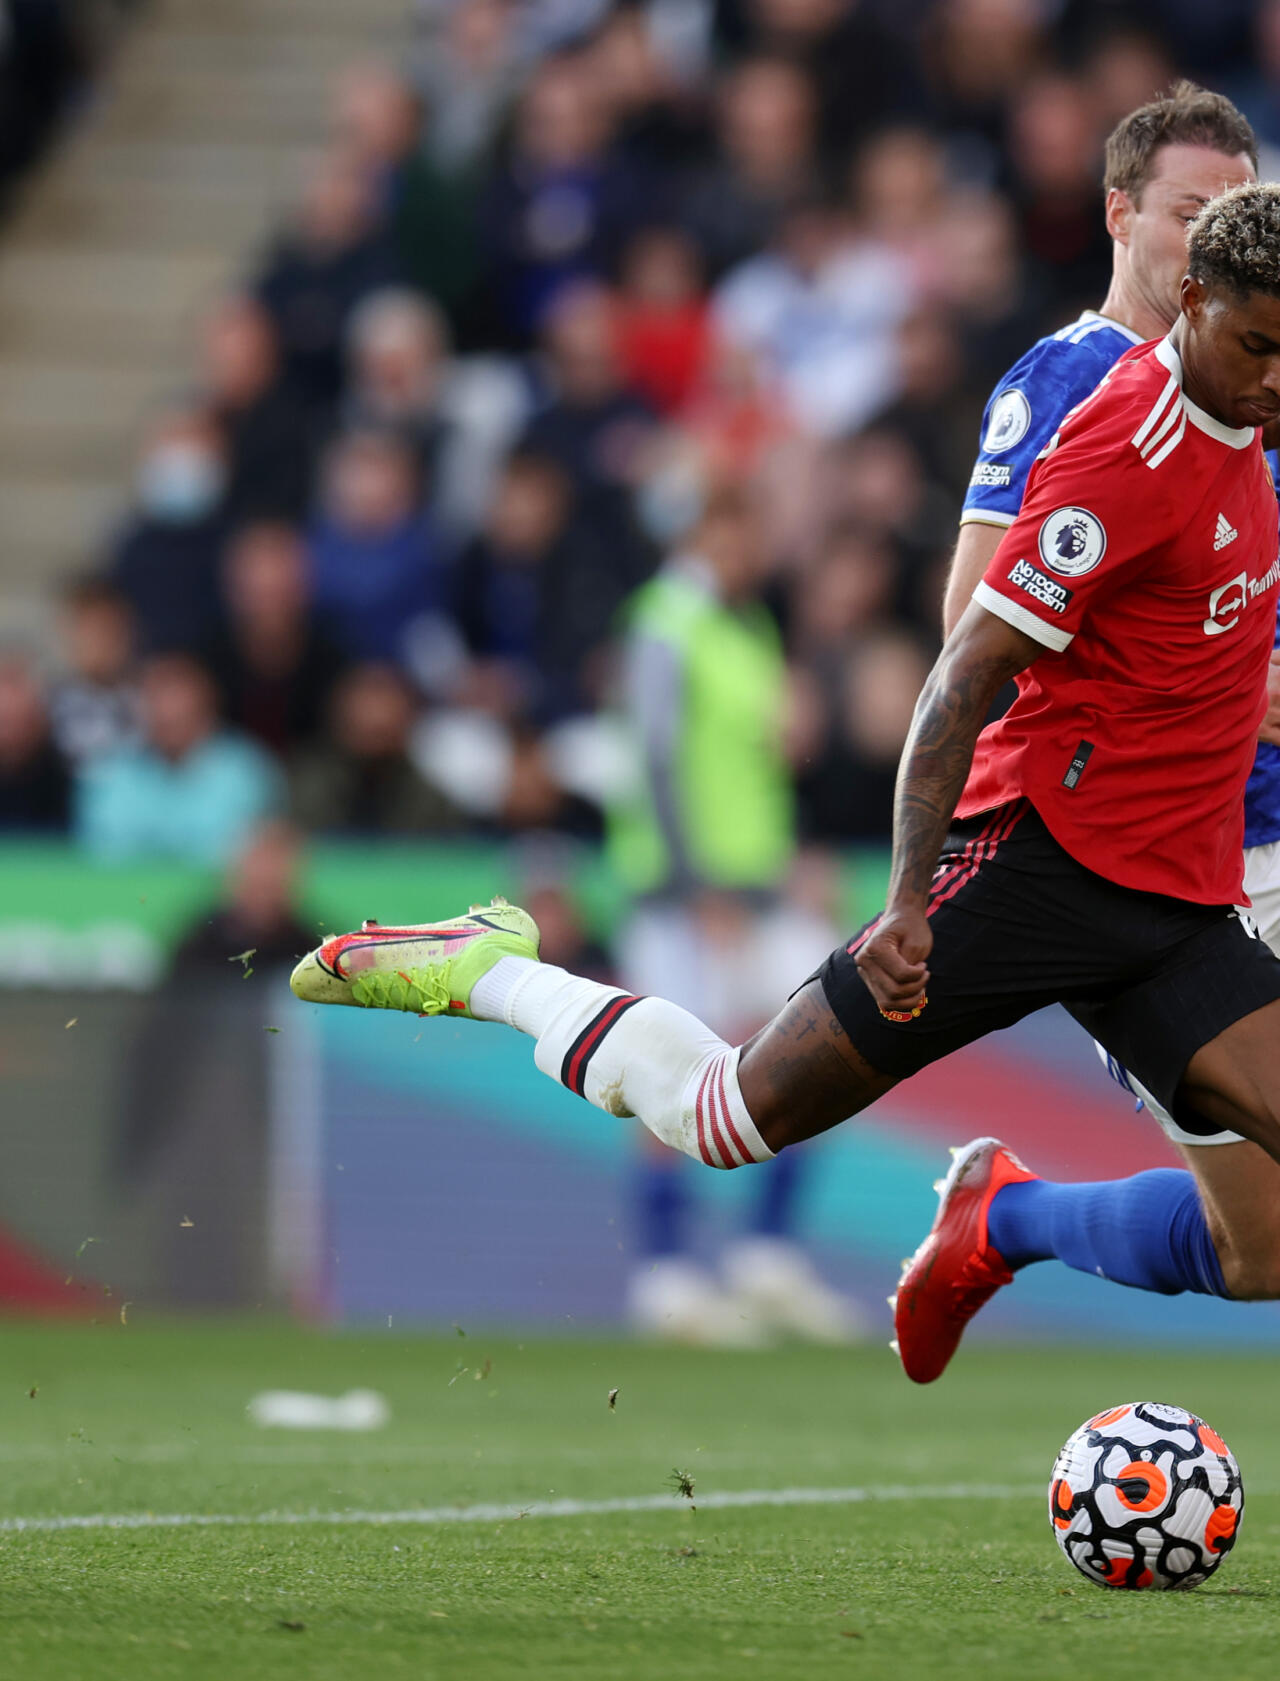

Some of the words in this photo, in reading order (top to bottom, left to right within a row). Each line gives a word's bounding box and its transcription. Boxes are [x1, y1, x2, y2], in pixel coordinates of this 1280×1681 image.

[1214, 529, 1238, 551] adidas
[1008, 569, 1028, 586] for
[1024, 581, 1066, 613] racism
[1013, 559, 1033, 577] No
[1031, 572, 1066, 600] room
